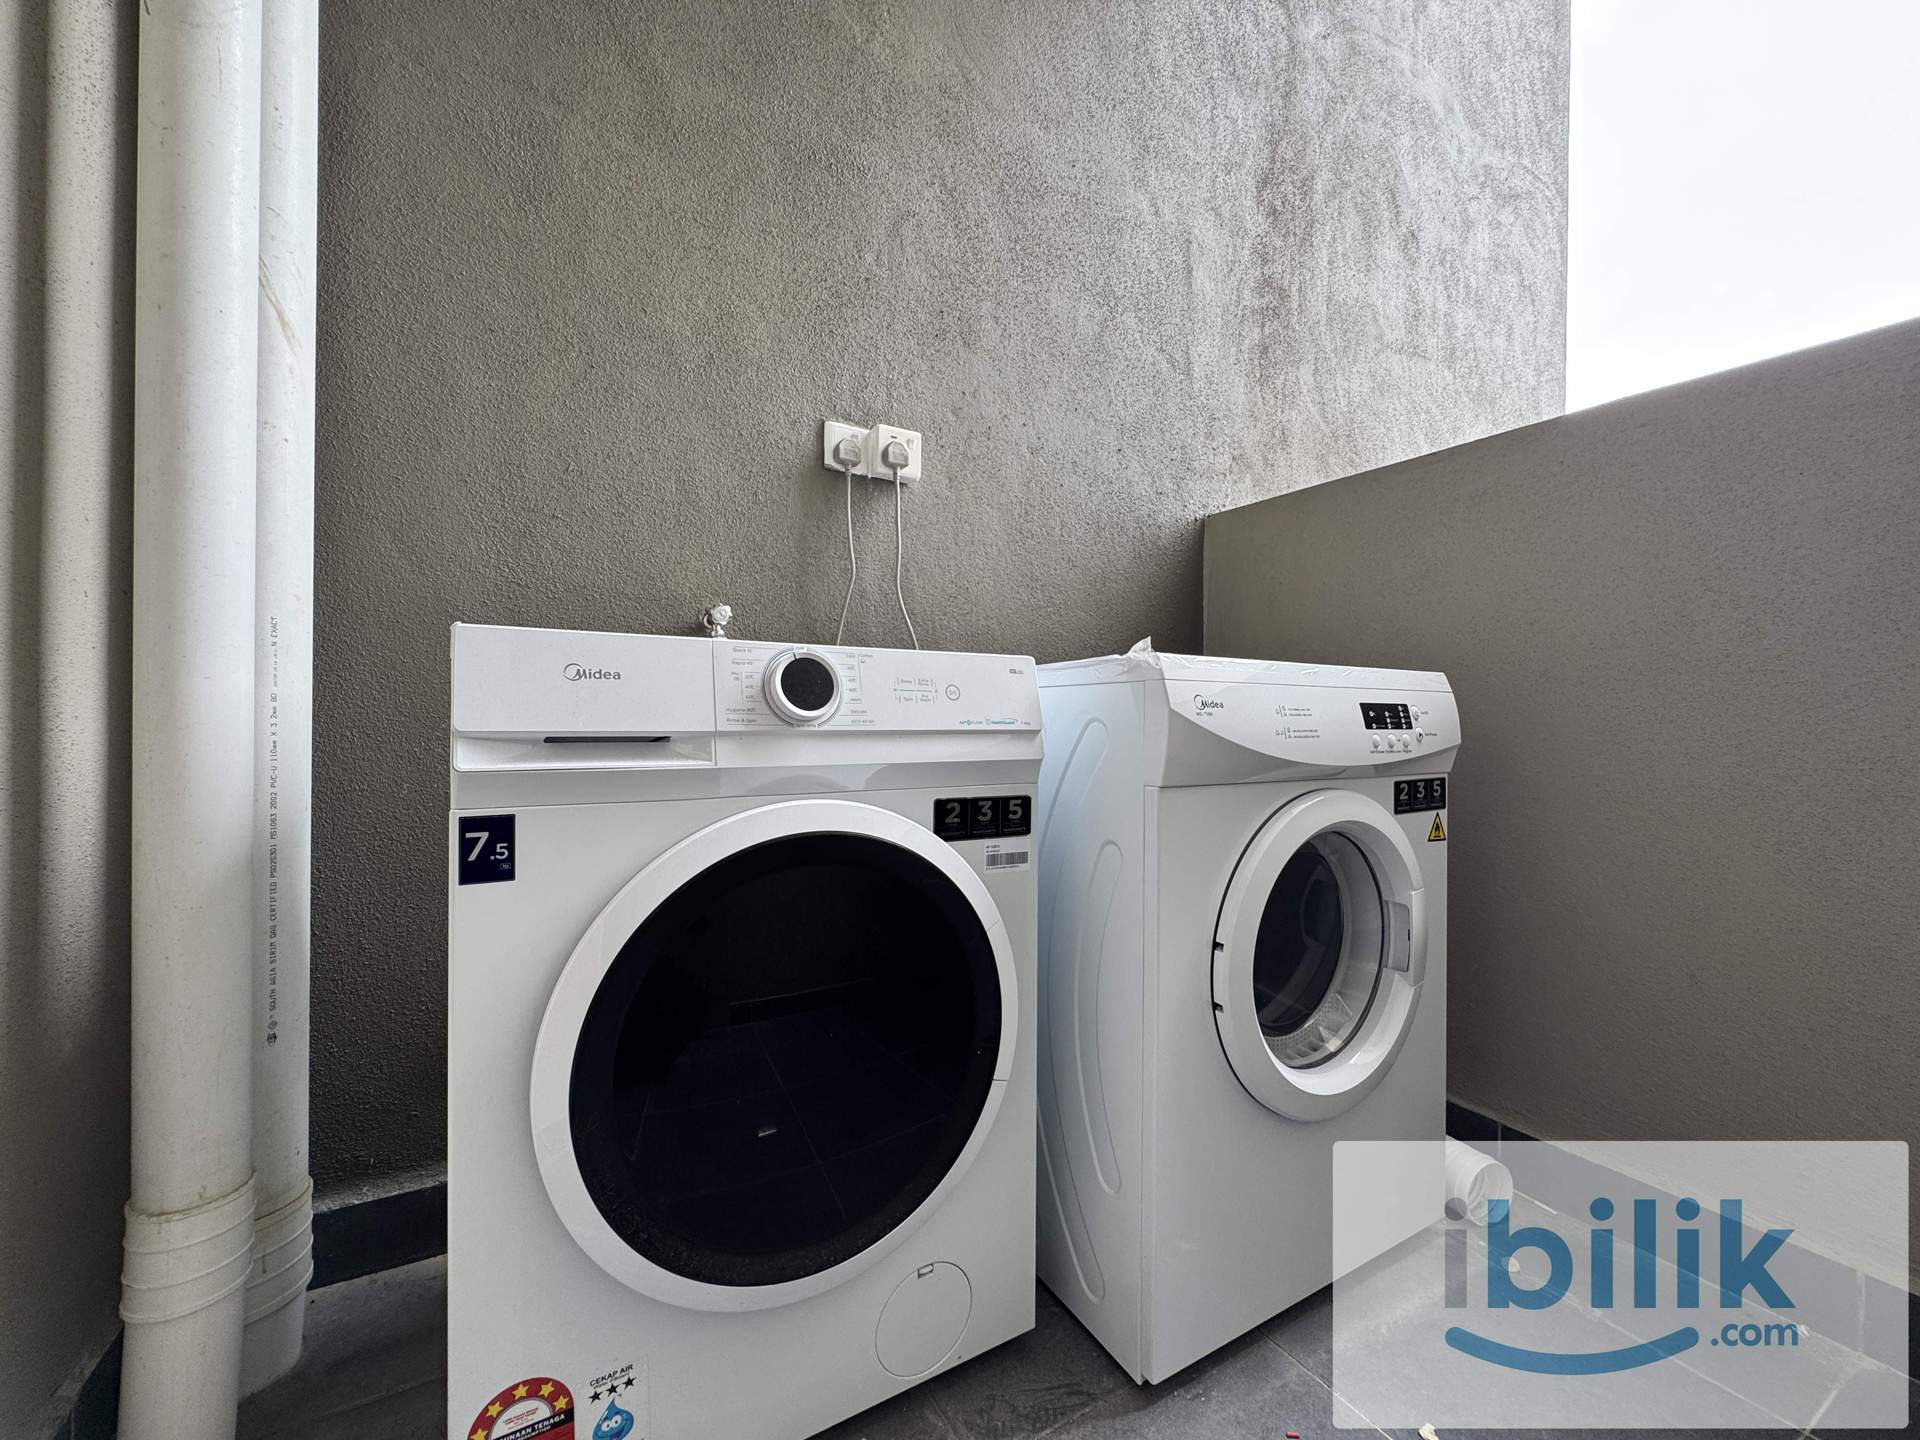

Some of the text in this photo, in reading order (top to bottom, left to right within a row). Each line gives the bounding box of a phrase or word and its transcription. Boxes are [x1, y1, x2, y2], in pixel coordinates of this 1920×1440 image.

[564, 663, 621, 681] Midea
[1194, 694, 1224, 711] Midea
[269, 765, 278, 788] PVC-U
[269, 791, 278, 809] 2002
[1399, 780, 1441, 800] 2 3 5
[945, 799, 1023, 823] 2 3 5
[465, 831, 509, 862] 7.5
[268, 882, 277, 921] CERTIFIED
[268, 941, 277, 964] SIRIM
[268, 967, 277, 985] ASIA
[268, 988, 277, 1012] SOUTH
[589, 1370, 618, 1387] CEKAP
[619, 1363, 634, 1375] AIR
[533, 1414, 565, 1430] TENAGA
